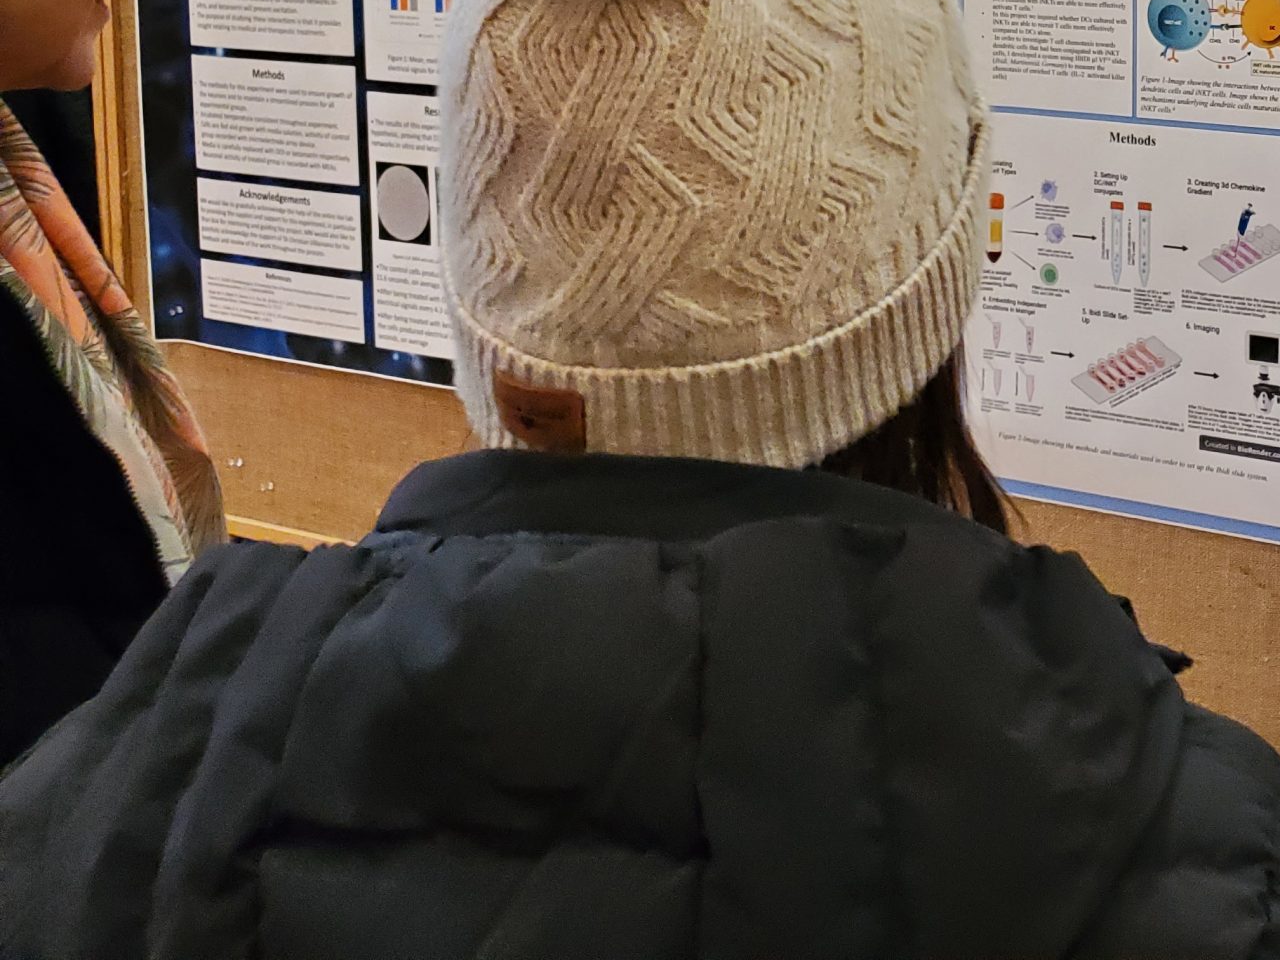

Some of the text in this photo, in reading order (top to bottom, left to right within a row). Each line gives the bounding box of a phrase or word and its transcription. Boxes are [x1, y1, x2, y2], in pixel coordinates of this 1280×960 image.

[252, 68, 286, 81] Methods
[1109, 131, 1156, 146] Methods
[1194, 178, 1219, 189] Creating
[1230, 182, 1265, 192] Chemokine
[239, 188, 311, 206] Acknowledgements
[1194, 324, 1220, 334] Imaging
